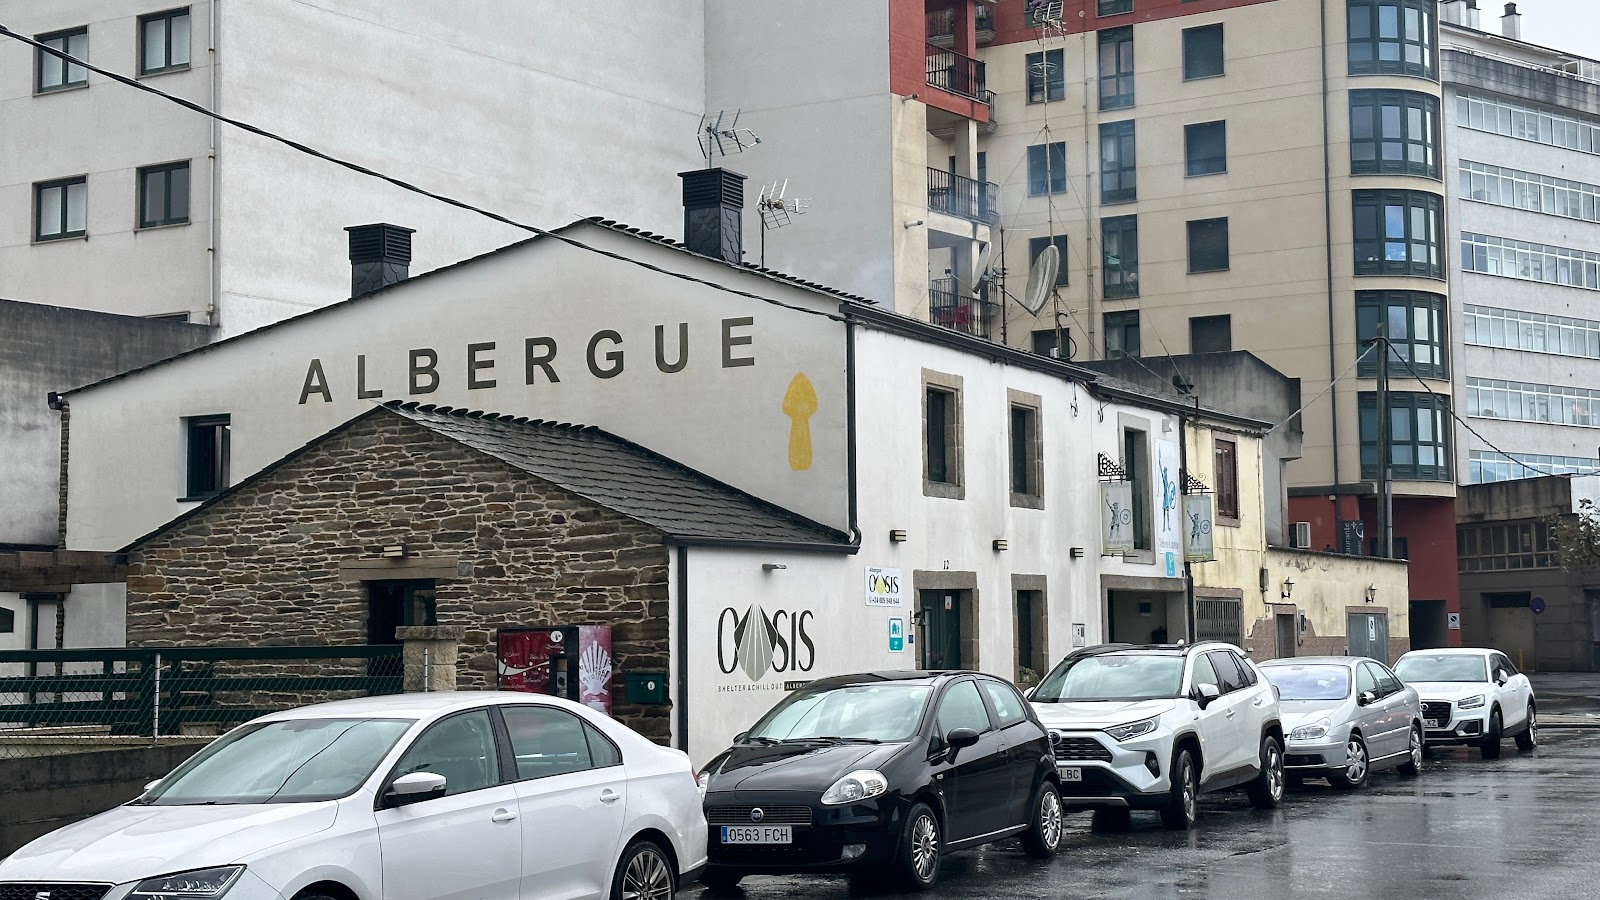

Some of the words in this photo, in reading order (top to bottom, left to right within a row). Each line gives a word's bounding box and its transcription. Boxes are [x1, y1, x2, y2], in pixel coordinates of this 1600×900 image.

[298, 316, 755, 405] ALBERGUE
[943, 560, 950, 570] 12
[868, 574, 898, 594] OASIS
[717, 602, 815, 682] OASIS
[1060, 769, 1079, 780] LBC
[729, 828, 760, 841] 0563
[764, 828, 788, 841] FCH
